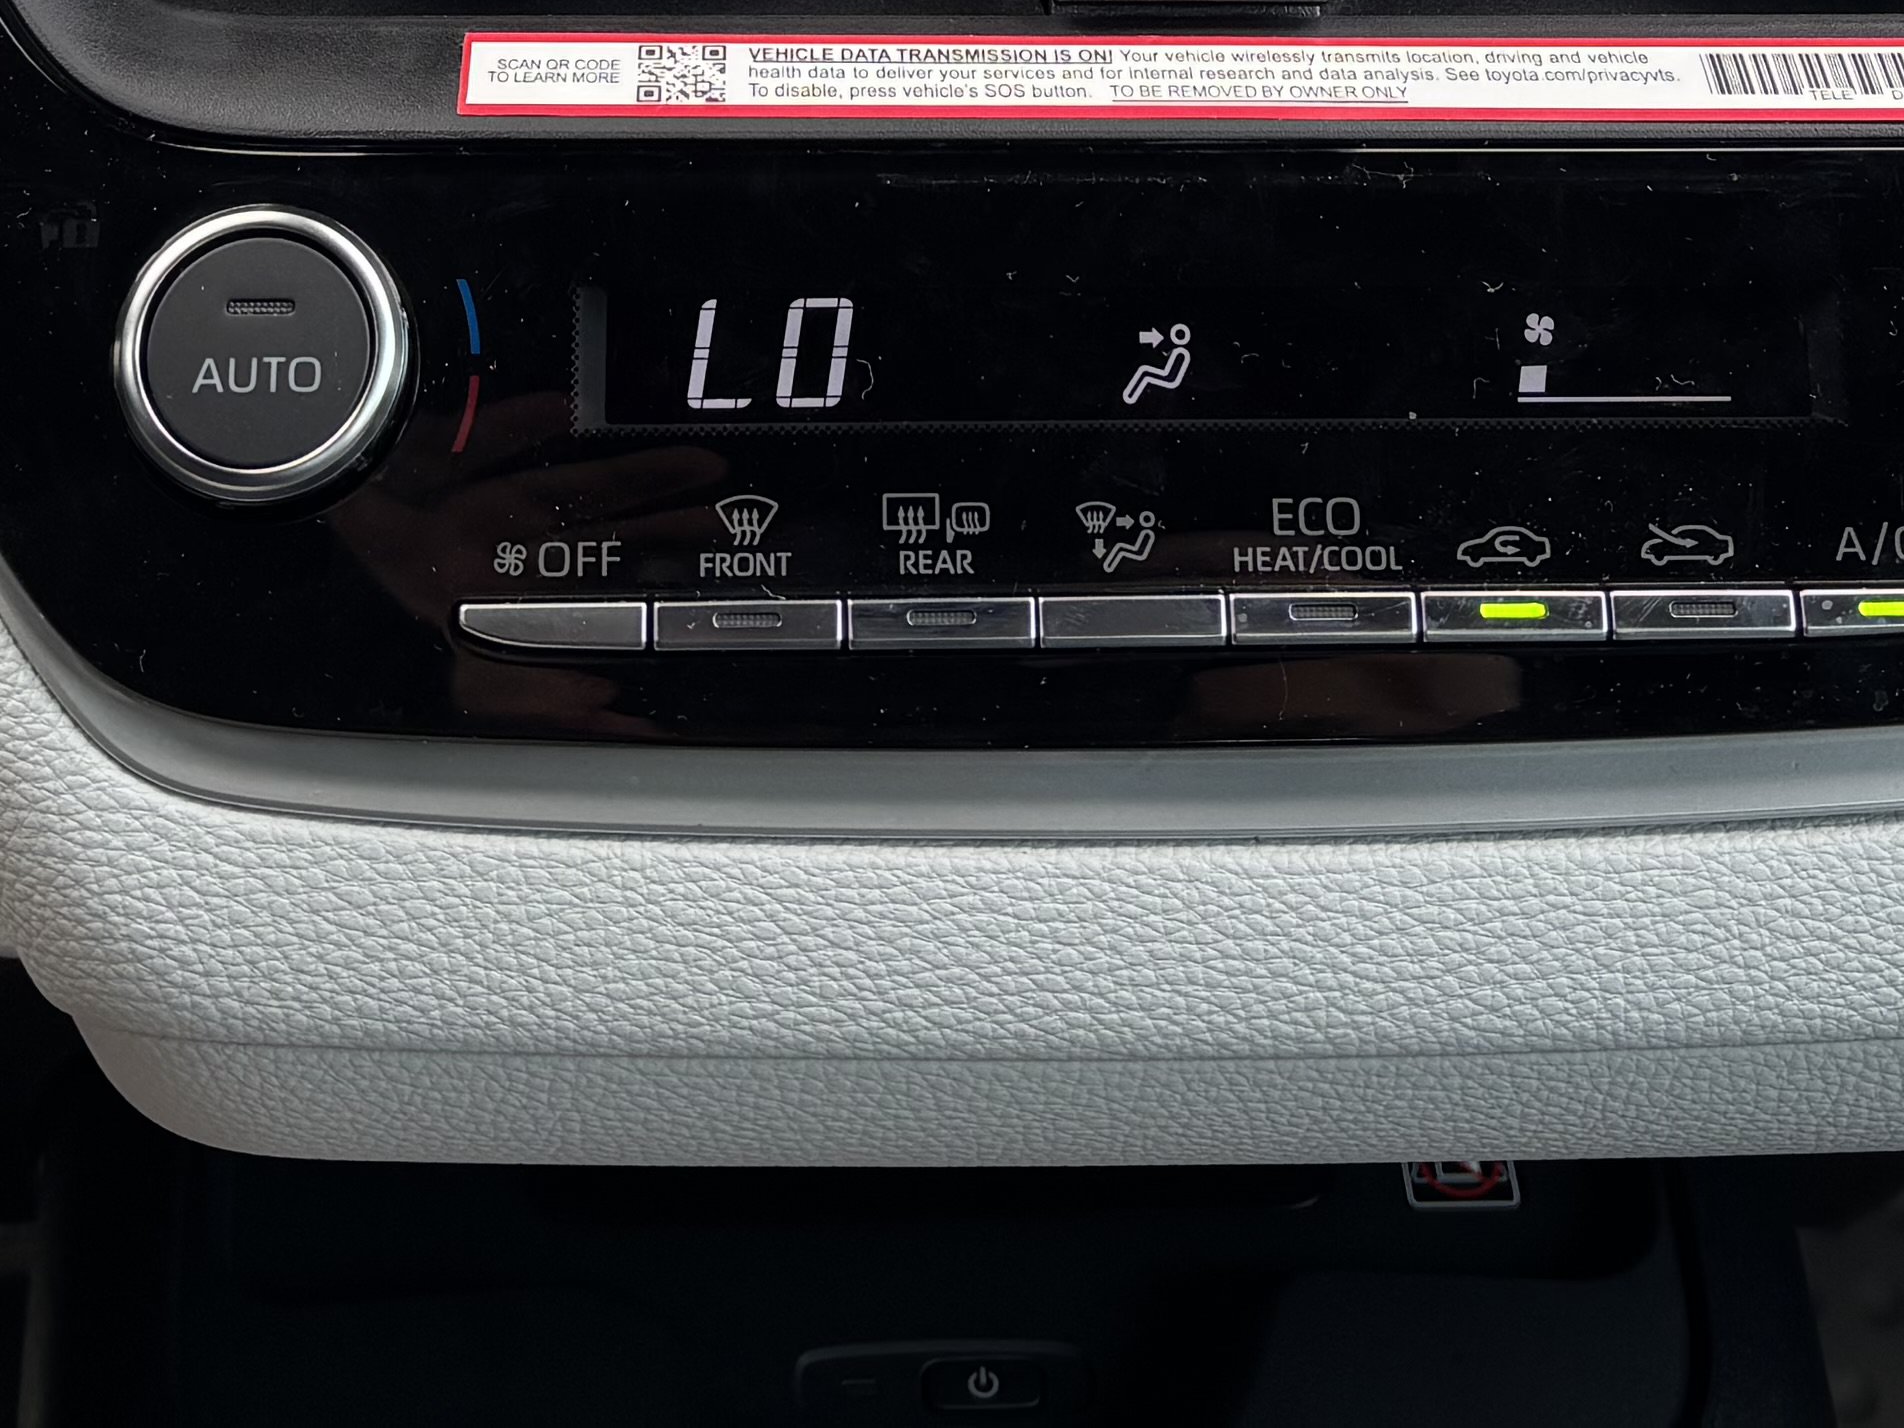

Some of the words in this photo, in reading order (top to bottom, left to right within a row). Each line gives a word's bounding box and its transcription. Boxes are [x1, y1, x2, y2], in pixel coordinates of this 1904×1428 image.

[497, 58, 541, 70] SCAN
[575, 58, 621, 70] CODE
[749, 48, 833, 61] VEHICLE
[841, 48, 891, 61] DATA
[897, 48, 1047, 63] TRANSMISSION
[1054, 49, 1072, 63] IS
[1120, 49, 1158, 62] Your
[1165, 50, 1225, 62] vehicle
[1232, 50, 1315, 65] wirelessly
[1322, 51, 1401, 63] transmits
[1407, 51, 1479, 65] location,
[1485, 50, 1543, 66] driving
[1549, 50, 1581, 64] and
[1588, 50, 1649, 64] vehicle
[488, 71, 509, 83] TO
[514, 71, 567, 83] LEARN
[572, 71, 621, 83] MORE
[749, 66, 801, 78] health
[808, 66, 846, 78] data
[854, 67, 869, 79] to
[876, 67, 933, 79] deliver
[940, 69, 977, 82] your
[984, 68, 1055, 80] services
[1062, 67, 1094, 80] and
[1100, 67, 1122, 80] for
[1129, 67, 1193, 80] internal
[1200, 67, 1275, 80] research
[1282, 67, 1312, 80] and
[1319, 68, 1357, 80] data
[1363, 68, 1440, 84] analysis.
[1446, 68, 1479, 81] See
[749, 83, 768, 97] To
[775, 83, 843, 99] disable,
[850, 86, 897, 100] press
[903, 84, 978, 98] vehicle's
[985, 84, 1025, 98] SOS
[1032, 84, 1092, 98] button.
[1110, 85, 1134, 97] TO
[1140, 85, 1162, 97] BE
[1168, 85, 1257, 98] REMOVED
[1262, 85, 1283, 98] BY
[1290, 86, 1357, 98] OWNER
[1362, 86, 1407, 98] ONLY
[1809, 90, 1853, 100] TELE
[191, 356, 322, 394] AUTO
[1271, 497, 1361, 537] ECO
[538, 540, 623, 578] OFF
[698, 551, 792, 578] FRONT
[898, 549, 975, 576] REAR
[1232, 544, 1403, 574] HEAT/COOL
